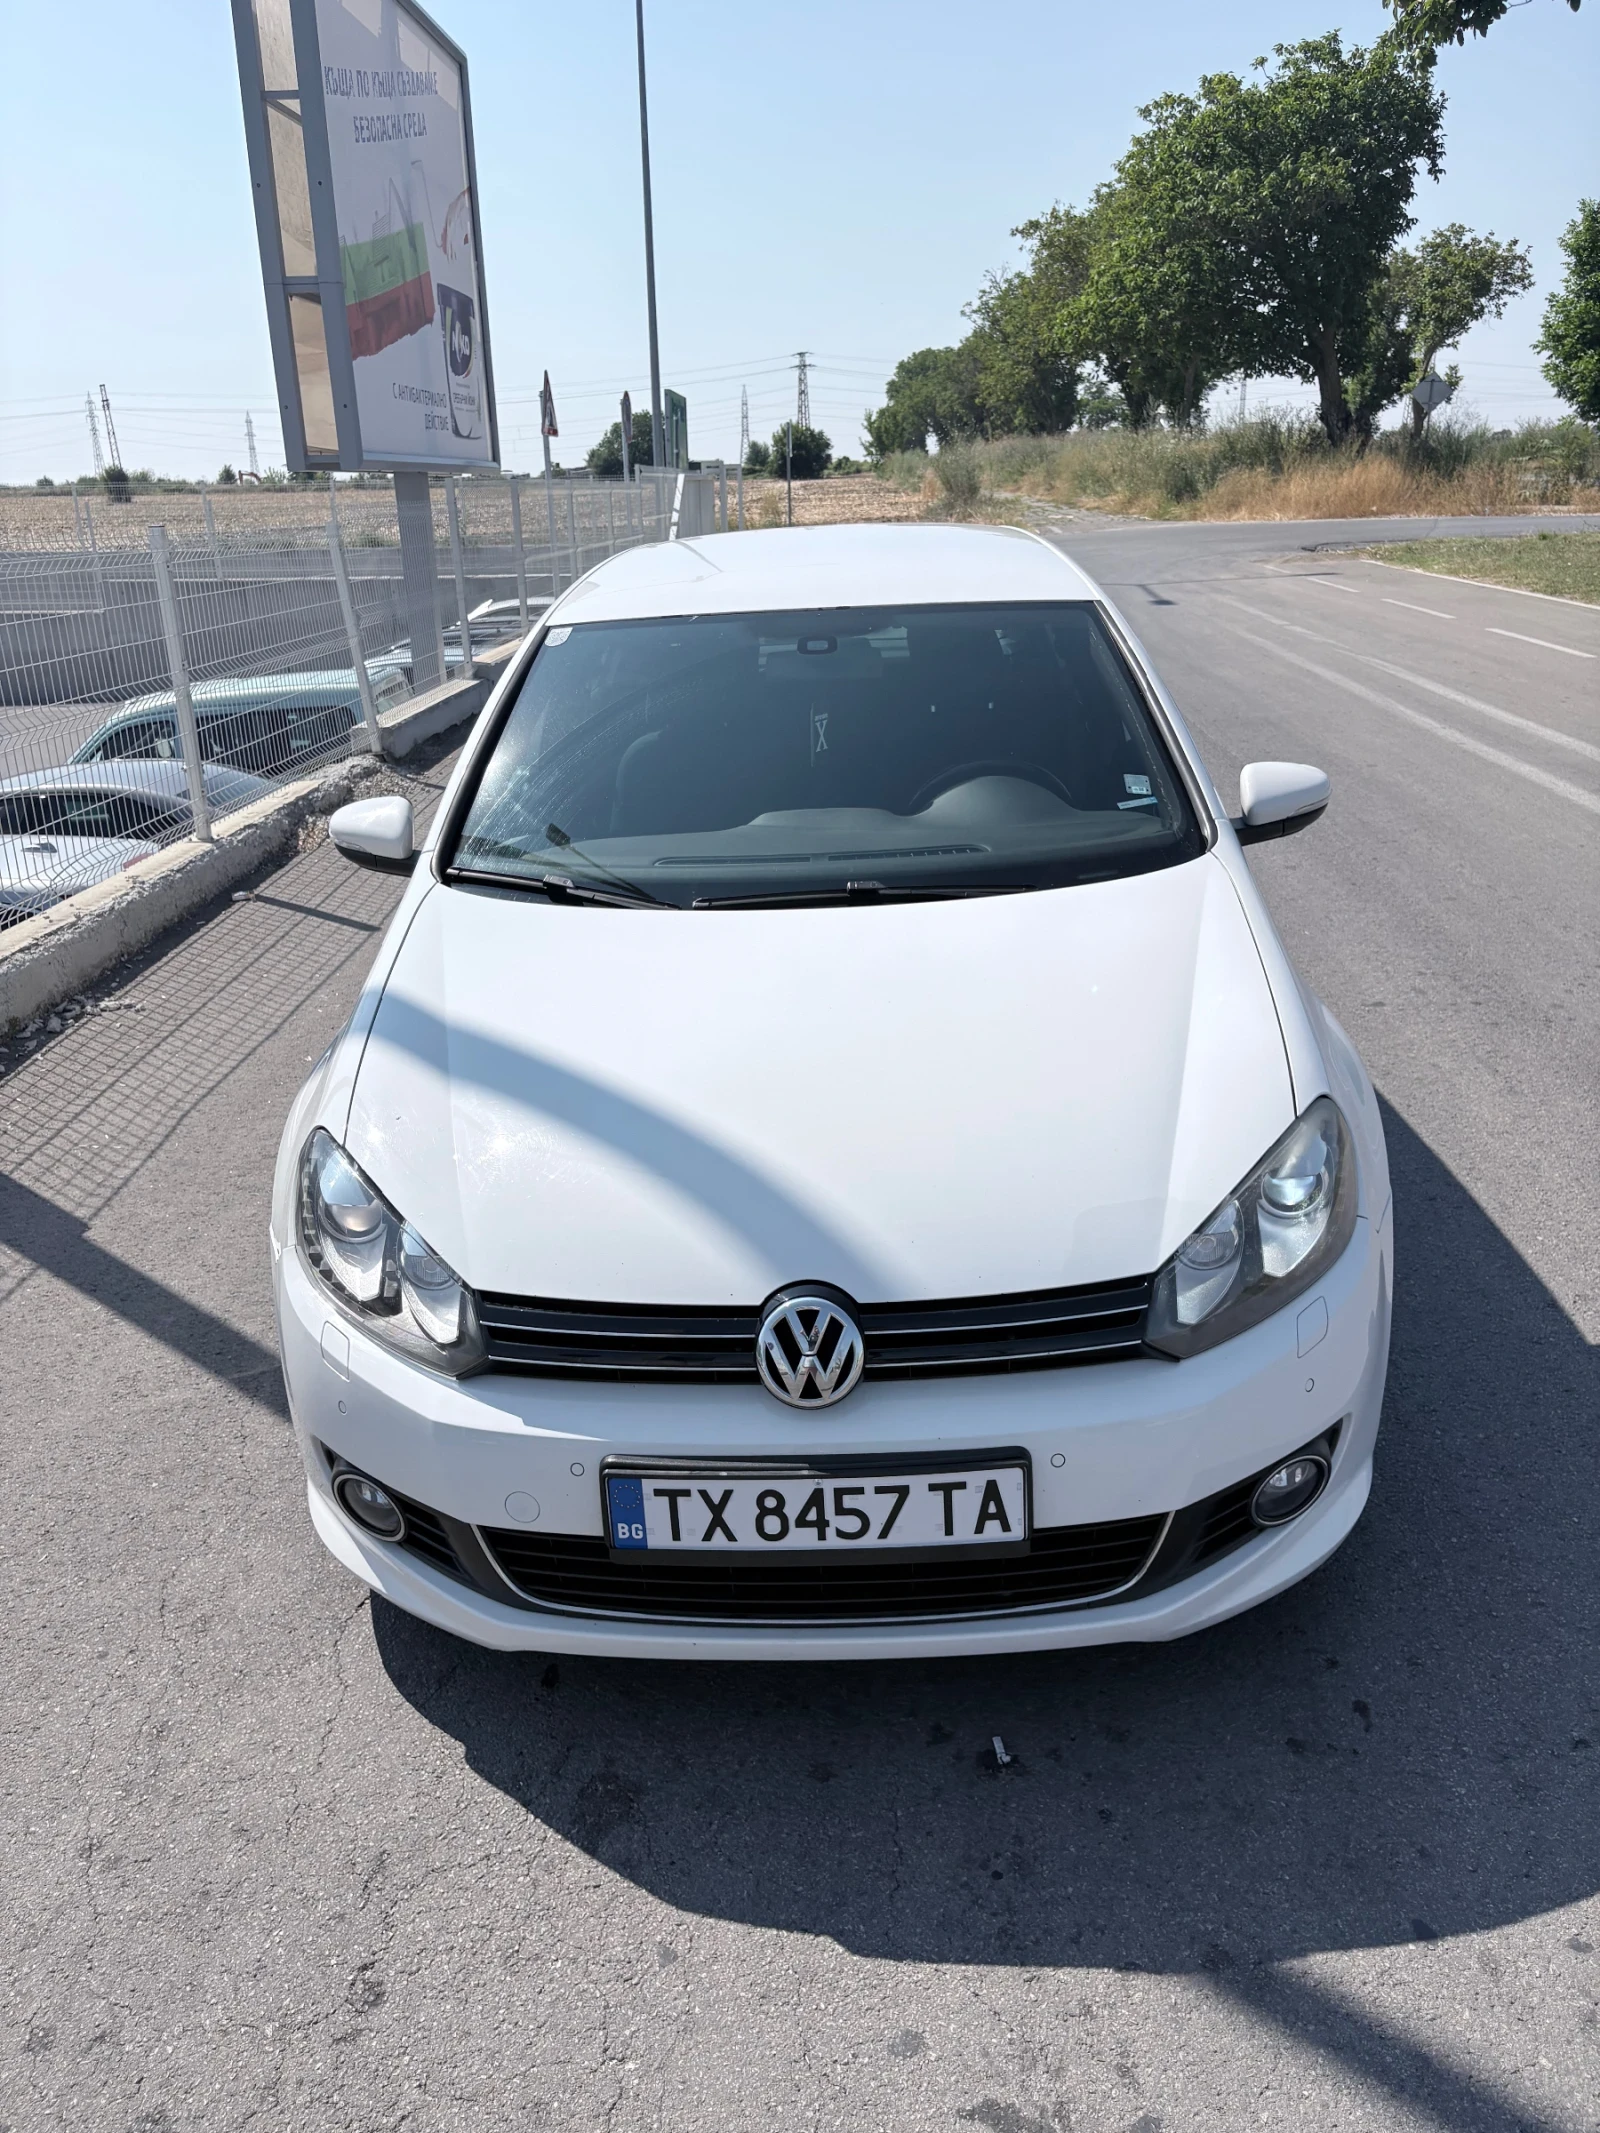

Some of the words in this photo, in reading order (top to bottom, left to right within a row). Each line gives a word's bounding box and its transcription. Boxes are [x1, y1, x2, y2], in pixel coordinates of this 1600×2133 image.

[324, 66, 355, 100] КЪЩА
[356, 70, 370, 98] ПО
[371, 71, 396, 100] КЪЩА
[353, 114, 402, 143] БЕЗОПАСНА
[403, 112, 427, 138] СРЕДА
[760, 1298, 860, 1408] VW
[653, 1488, 738, 1542] TX
[755, 1485, 910, 1542] 8457
[928, 1479, 1012, 1537] TA
[617, 1523, 644, 1540] BG
